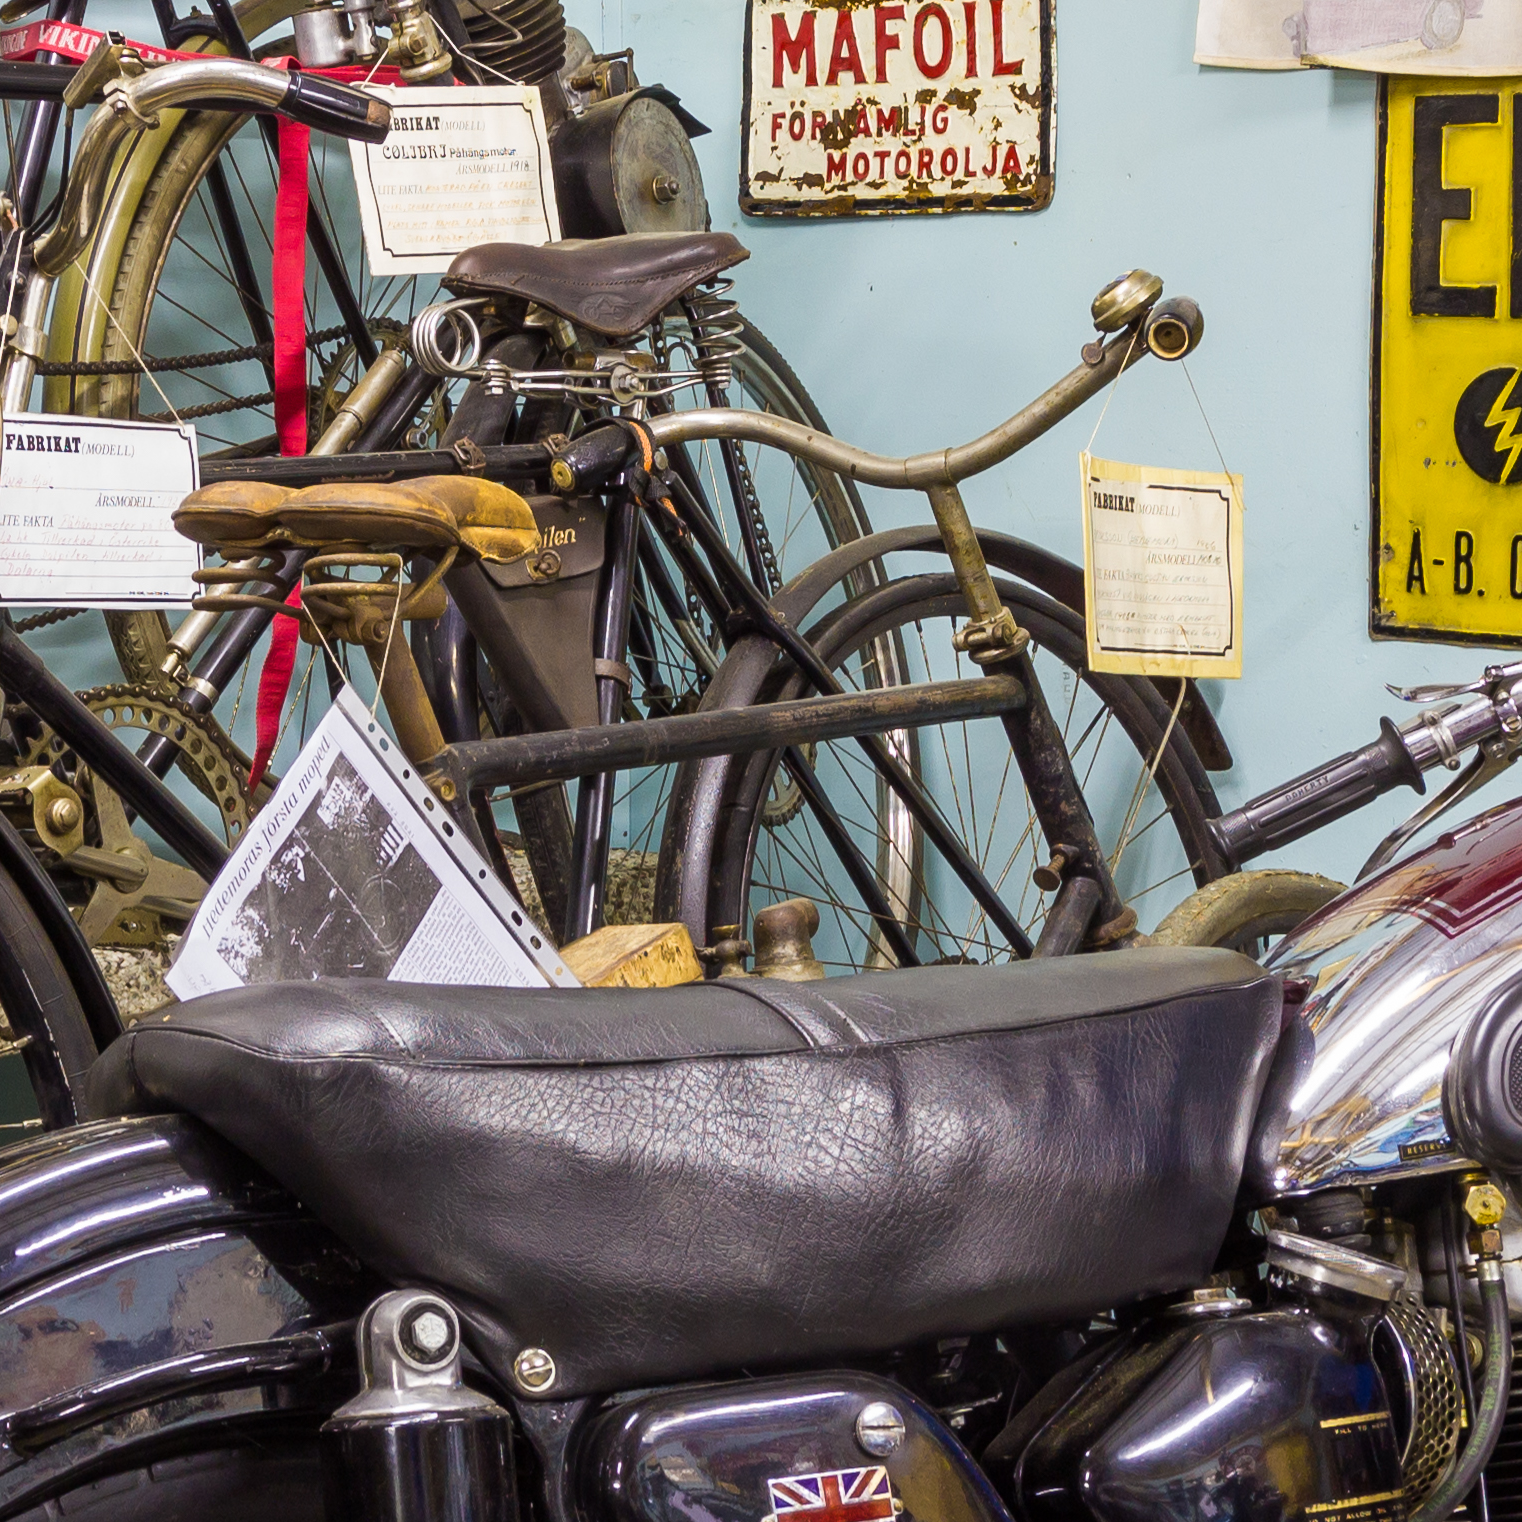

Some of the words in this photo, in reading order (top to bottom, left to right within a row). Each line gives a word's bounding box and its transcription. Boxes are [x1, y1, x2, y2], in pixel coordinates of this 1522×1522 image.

[771, 0, 1025, 88] MAFOIL
[825, 143, 1024, 183] MOTOROLJA
[5, 433, 81, 453] FABRIKAT
[81, 443, 135, 458] (MODELL)
[1093, 491, 1136, 513] FABRIKAT
[23, 515, 54, 528] FAKTA
[1284, 775, 1330, 802] DOHERTY
[202, 842, 264, 941] Hedemoras
[265, 792, 299, 854] första
[299, 734, 331, 796] moped
